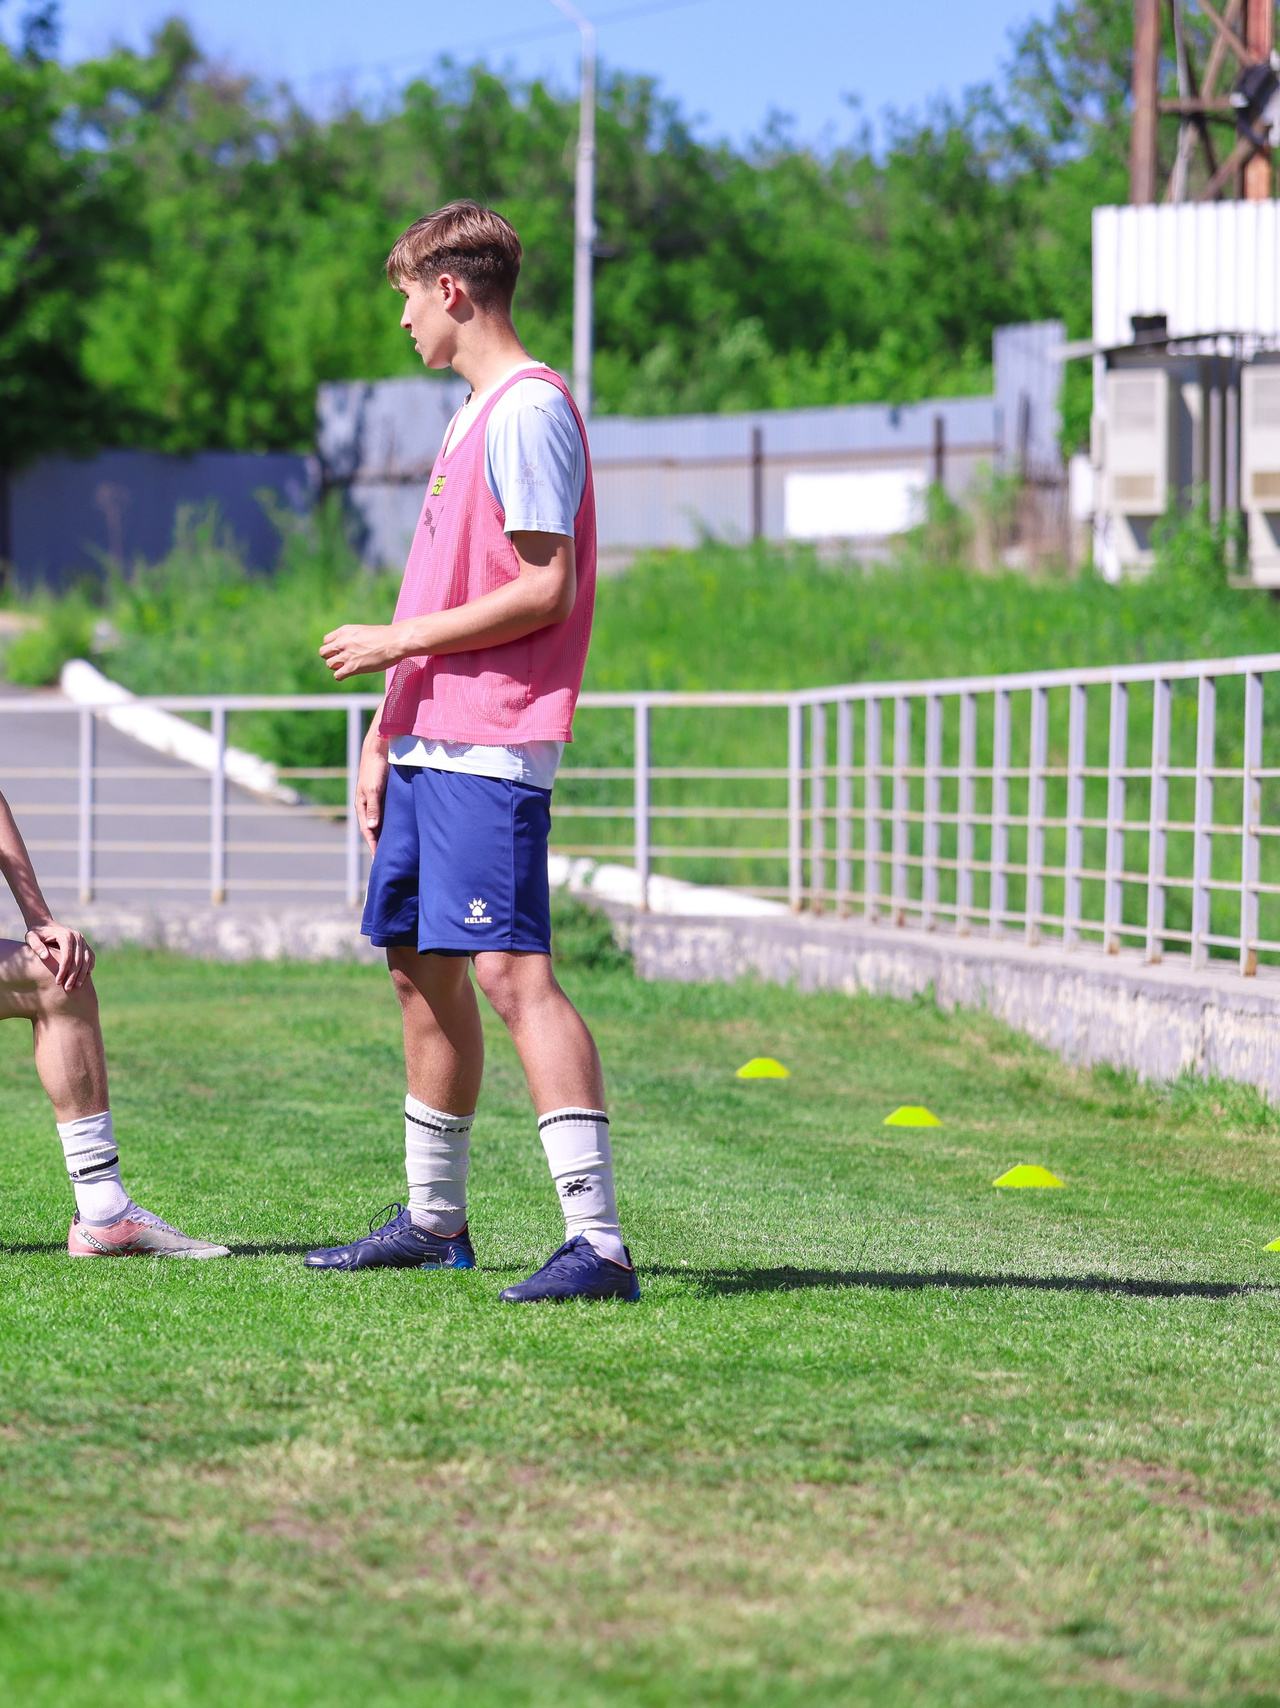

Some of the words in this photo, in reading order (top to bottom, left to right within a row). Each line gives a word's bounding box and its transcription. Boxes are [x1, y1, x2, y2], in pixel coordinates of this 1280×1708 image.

[464, 916, 493, 924] KELME
[444, 1124, 472, 1133] KEL
[562, 1186, 593, 1198] KELME
[80, 1229, 108, 1253] Kappa
[412, 1231, 427, 1242] COPA
